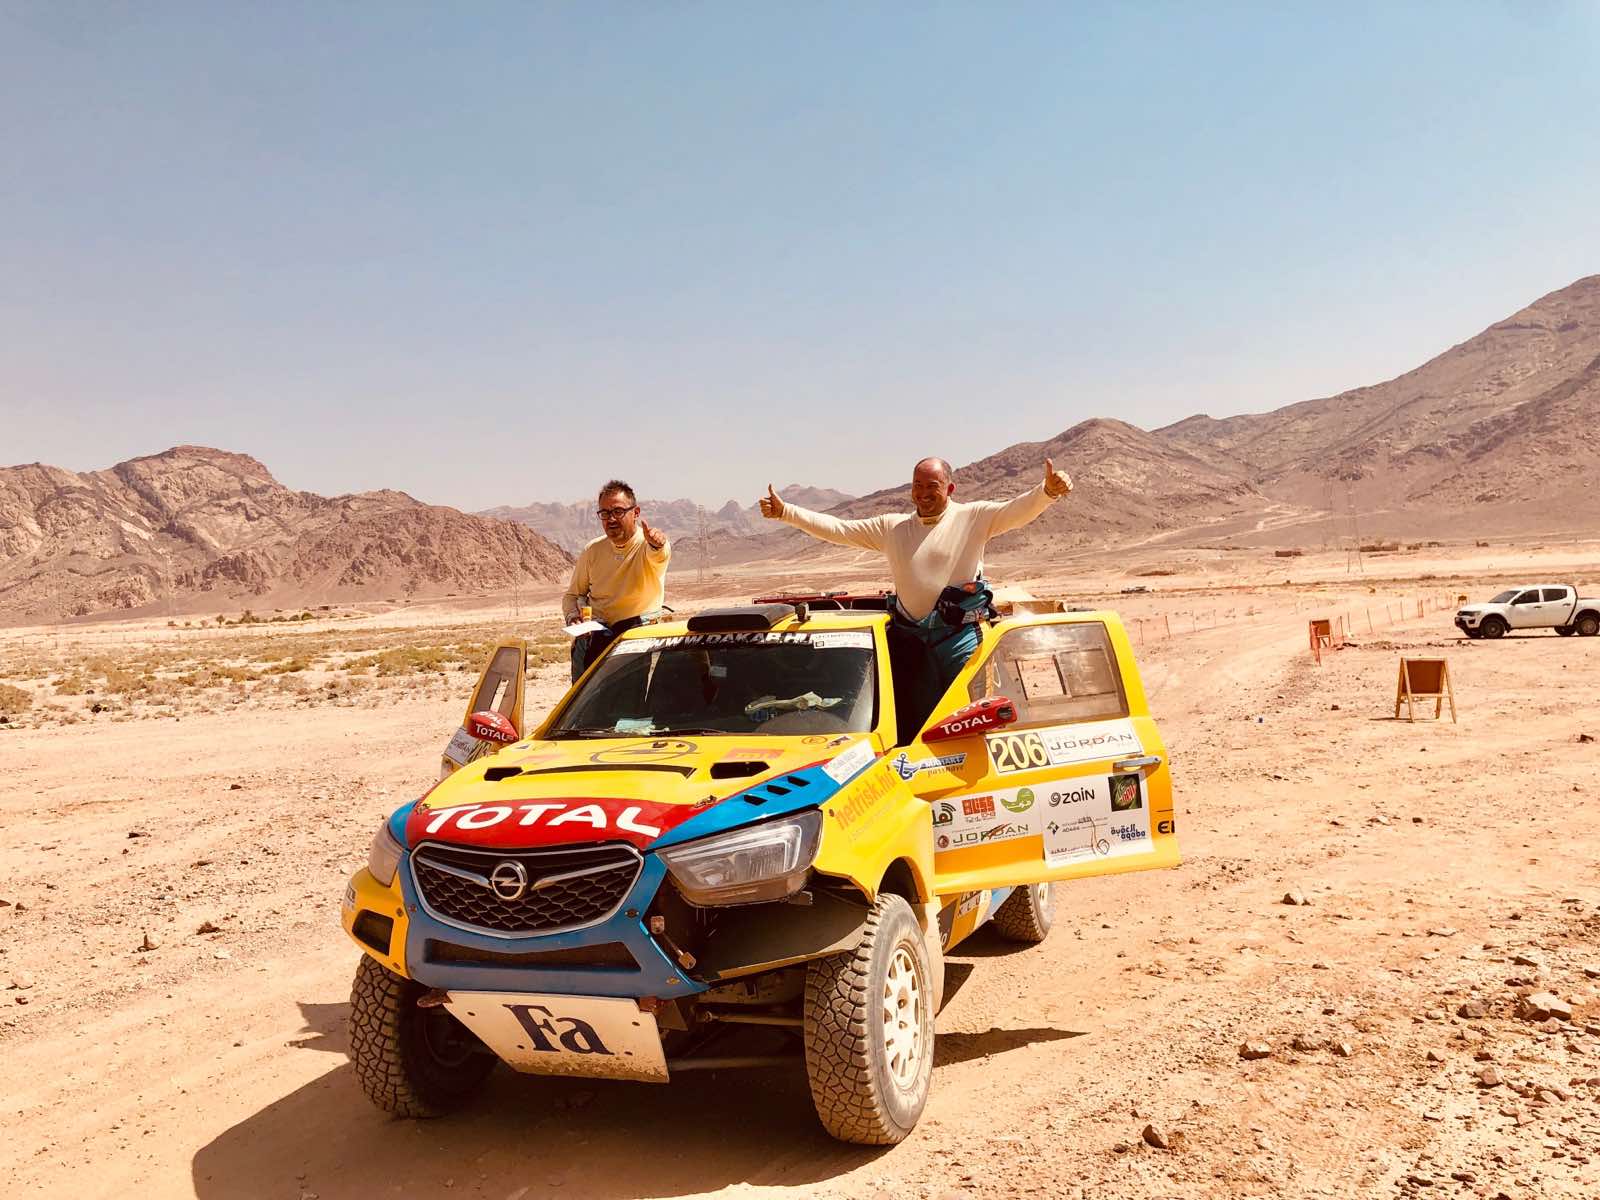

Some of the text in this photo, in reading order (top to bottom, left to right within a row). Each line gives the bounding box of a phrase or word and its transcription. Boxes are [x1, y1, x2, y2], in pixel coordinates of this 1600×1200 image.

[475, 723, 508, 741] TOTAL
[941, 714, 993, 735] TOTAL
[990, 733, 1048, 771] 206
[1050, 732, 1133, 751] JORDAN
[834, 768, 897, 831] netrisk.hu
[425, 803, 662, 838] TOTAL
[952, 823, 1029, 845] JORDAN
[1120, 828, 1146, 841] aqaba
[502, 1003, 615, 1056] Fa
